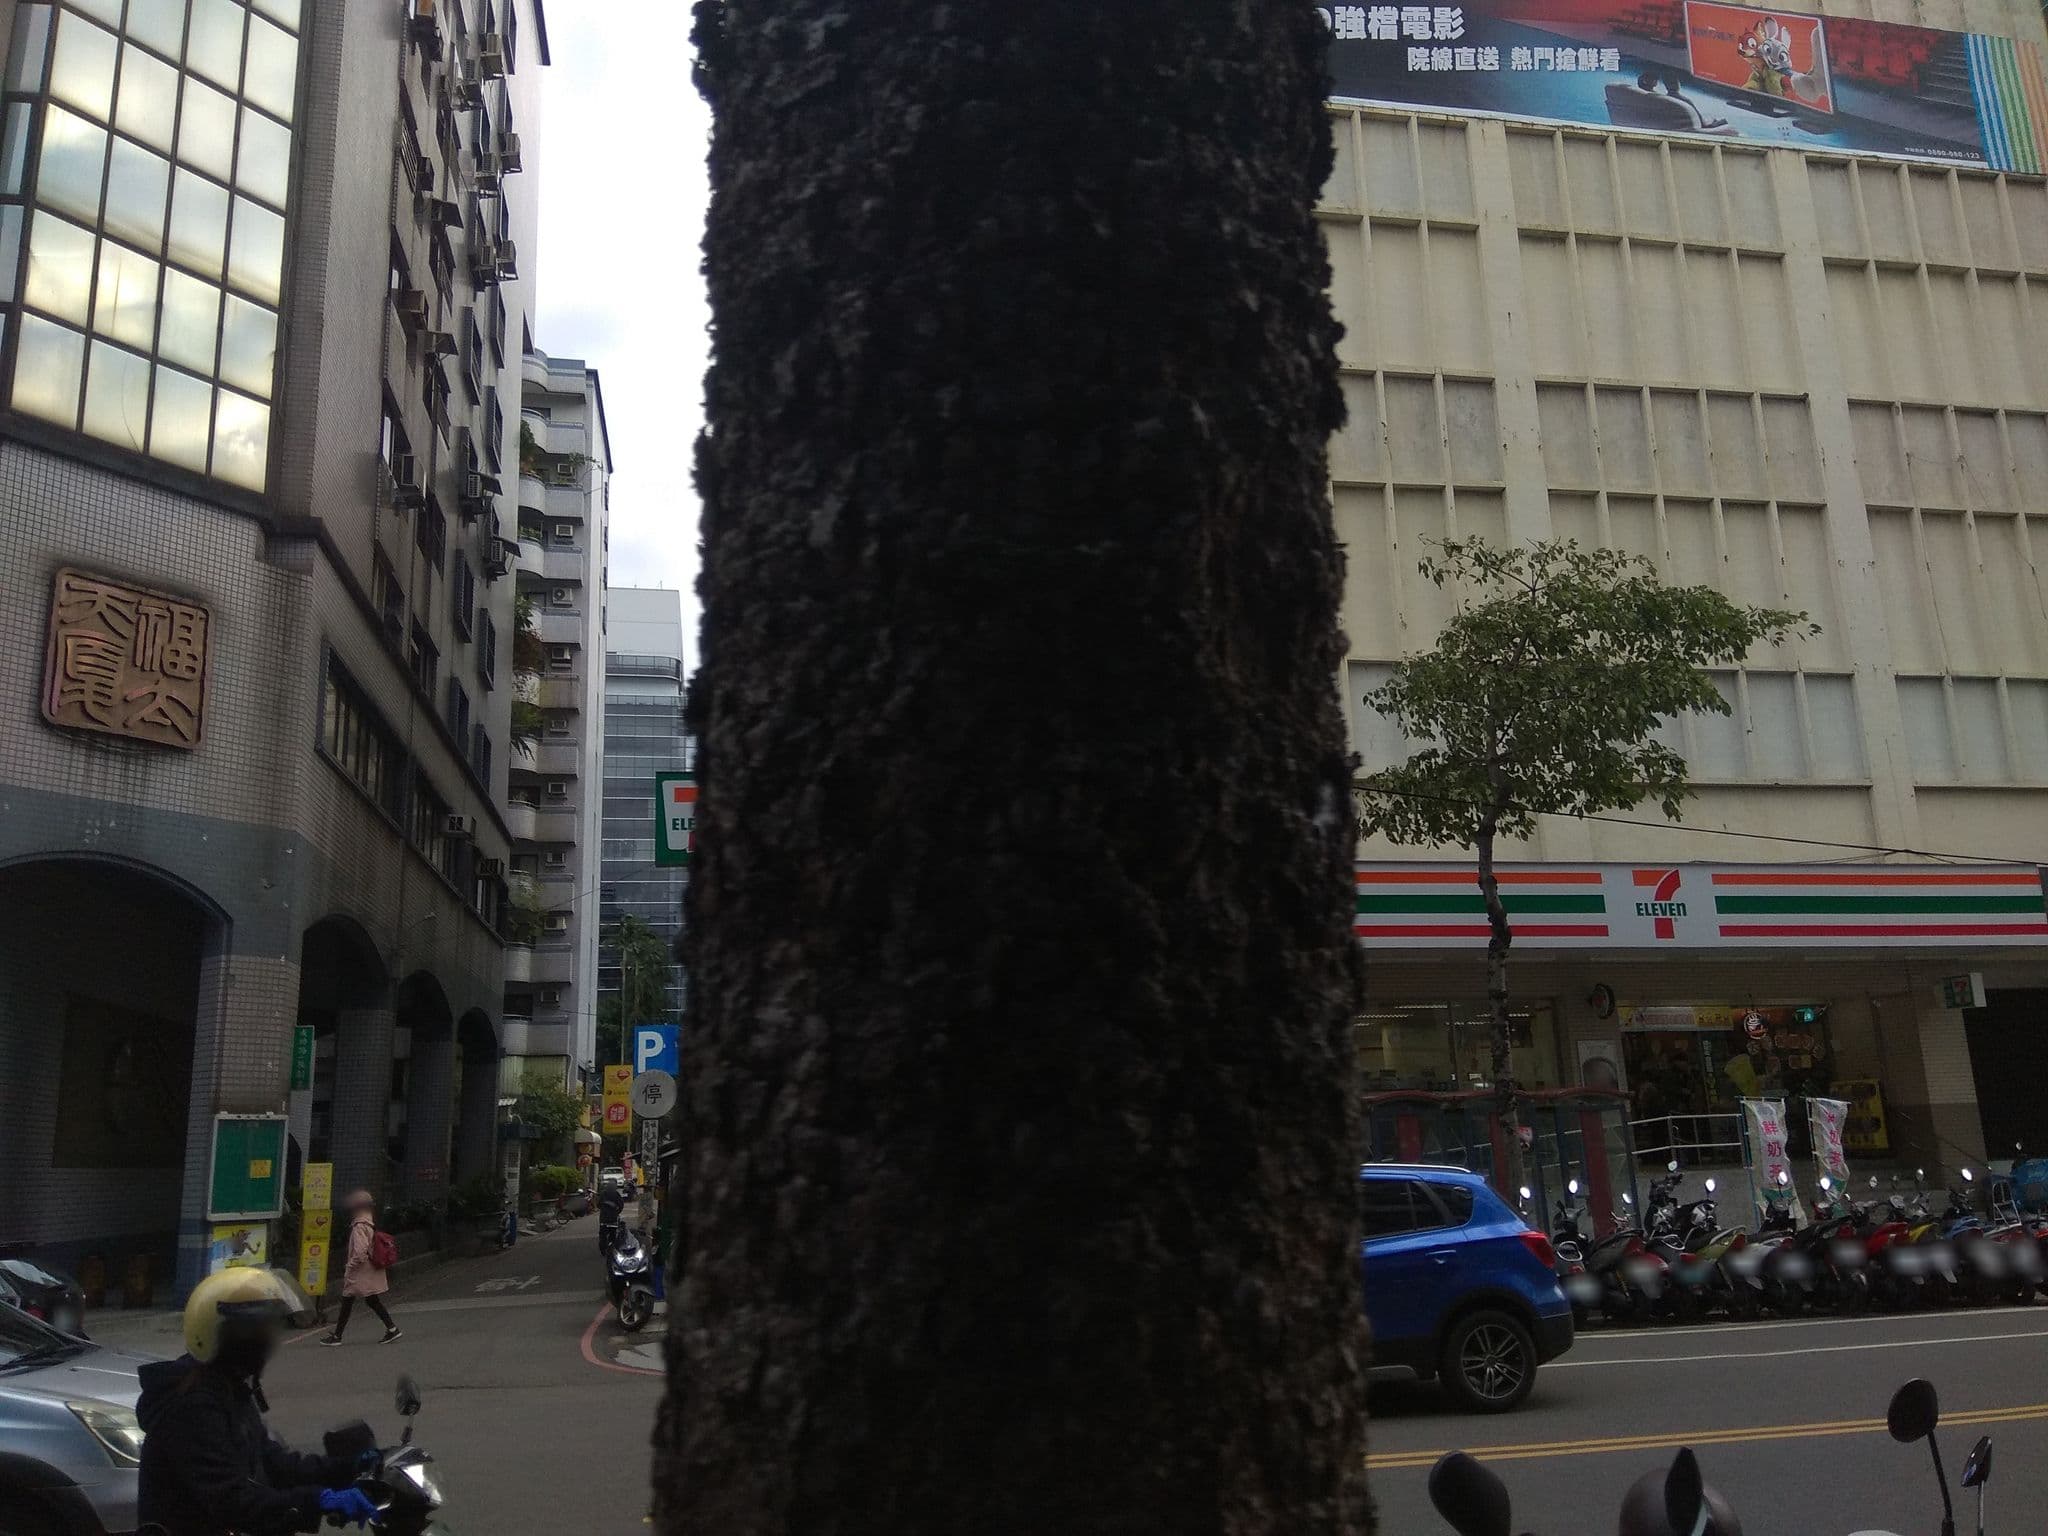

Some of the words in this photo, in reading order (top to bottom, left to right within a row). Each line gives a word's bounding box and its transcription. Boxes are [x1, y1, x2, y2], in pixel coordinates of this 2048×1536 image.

[1334, 6, 1465, 40] 強檔電影
[1407, 46, 1500, 72] 院線直送
[1511, 47, 1620, 72] 熱門搶鮮看
[637, 1031, 664, 1073] P
[642, 1083, 662, 1105] 停
